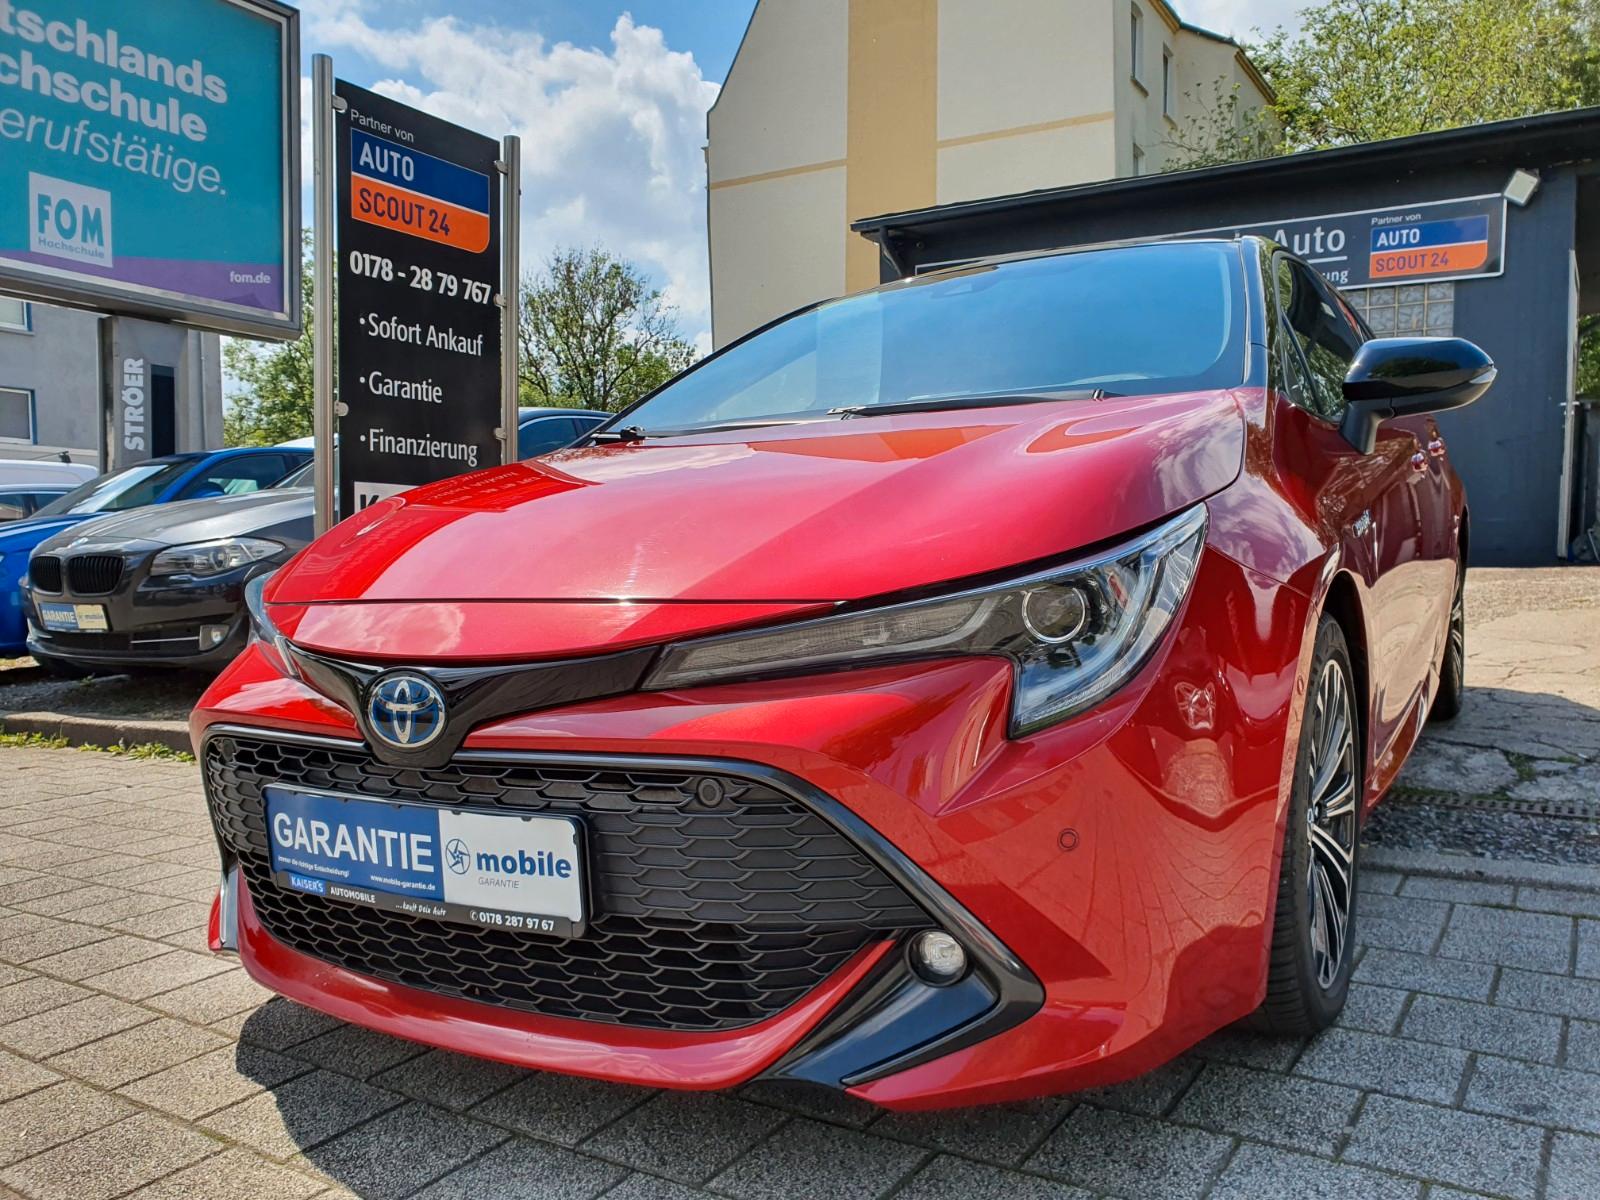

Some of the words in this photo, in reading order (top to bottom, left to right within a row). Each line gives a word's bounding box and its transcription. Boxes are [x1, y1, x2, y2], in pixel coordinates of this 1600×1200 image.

[0, 50, 208, 142] chschule
[350, 108, 392, 135] Partner
[394, 128, 415, 143] von
[359, 141, 415, 183] AUTO
[37, 193, 105, 248] FOM
[359, 187, 425, 229] SCOUT
[429, 208, 450, 237] 24
[1371, 214, 1403, 226] Partner
[1405, 213, 1422, 222] von
[38, 236, 105, 259] Hochschule
[1274, 226, 1346, 256] Auto
[1377, 228, 1420, 248] AUTO
[229, 270, 272, 284] fom.de
[349, 250, 394, 282] 0178
[409, 265, 433, 291] 28
[436, 271, 458, 297] 79
[462, 278, 491, 305] 767
[1375, 253, 1428, 273] SCOUT
[1430, 250, 1449, 268] 24
[368, 313, 422, 346] Sofort
[425, 325, 483, 357] Ankauf
[368, 371, 443, 404] Garantie
[121, 357, 145, 452] STRÖER
[369, 428, 478, 468] Finanzierung
[273, 812, 435, 873] GARANTIE
[476, 849, 572, 879] mobile
[330, 886, 376, 904] AUTOMOBILE
[478, 876, 520, 889] GARANTIE
[479, 911, 503, 925] 0178
[505, 914, 523, 927] 287
[526, 917, 539, 930] 97
[541, 919, 554, 932] 67
